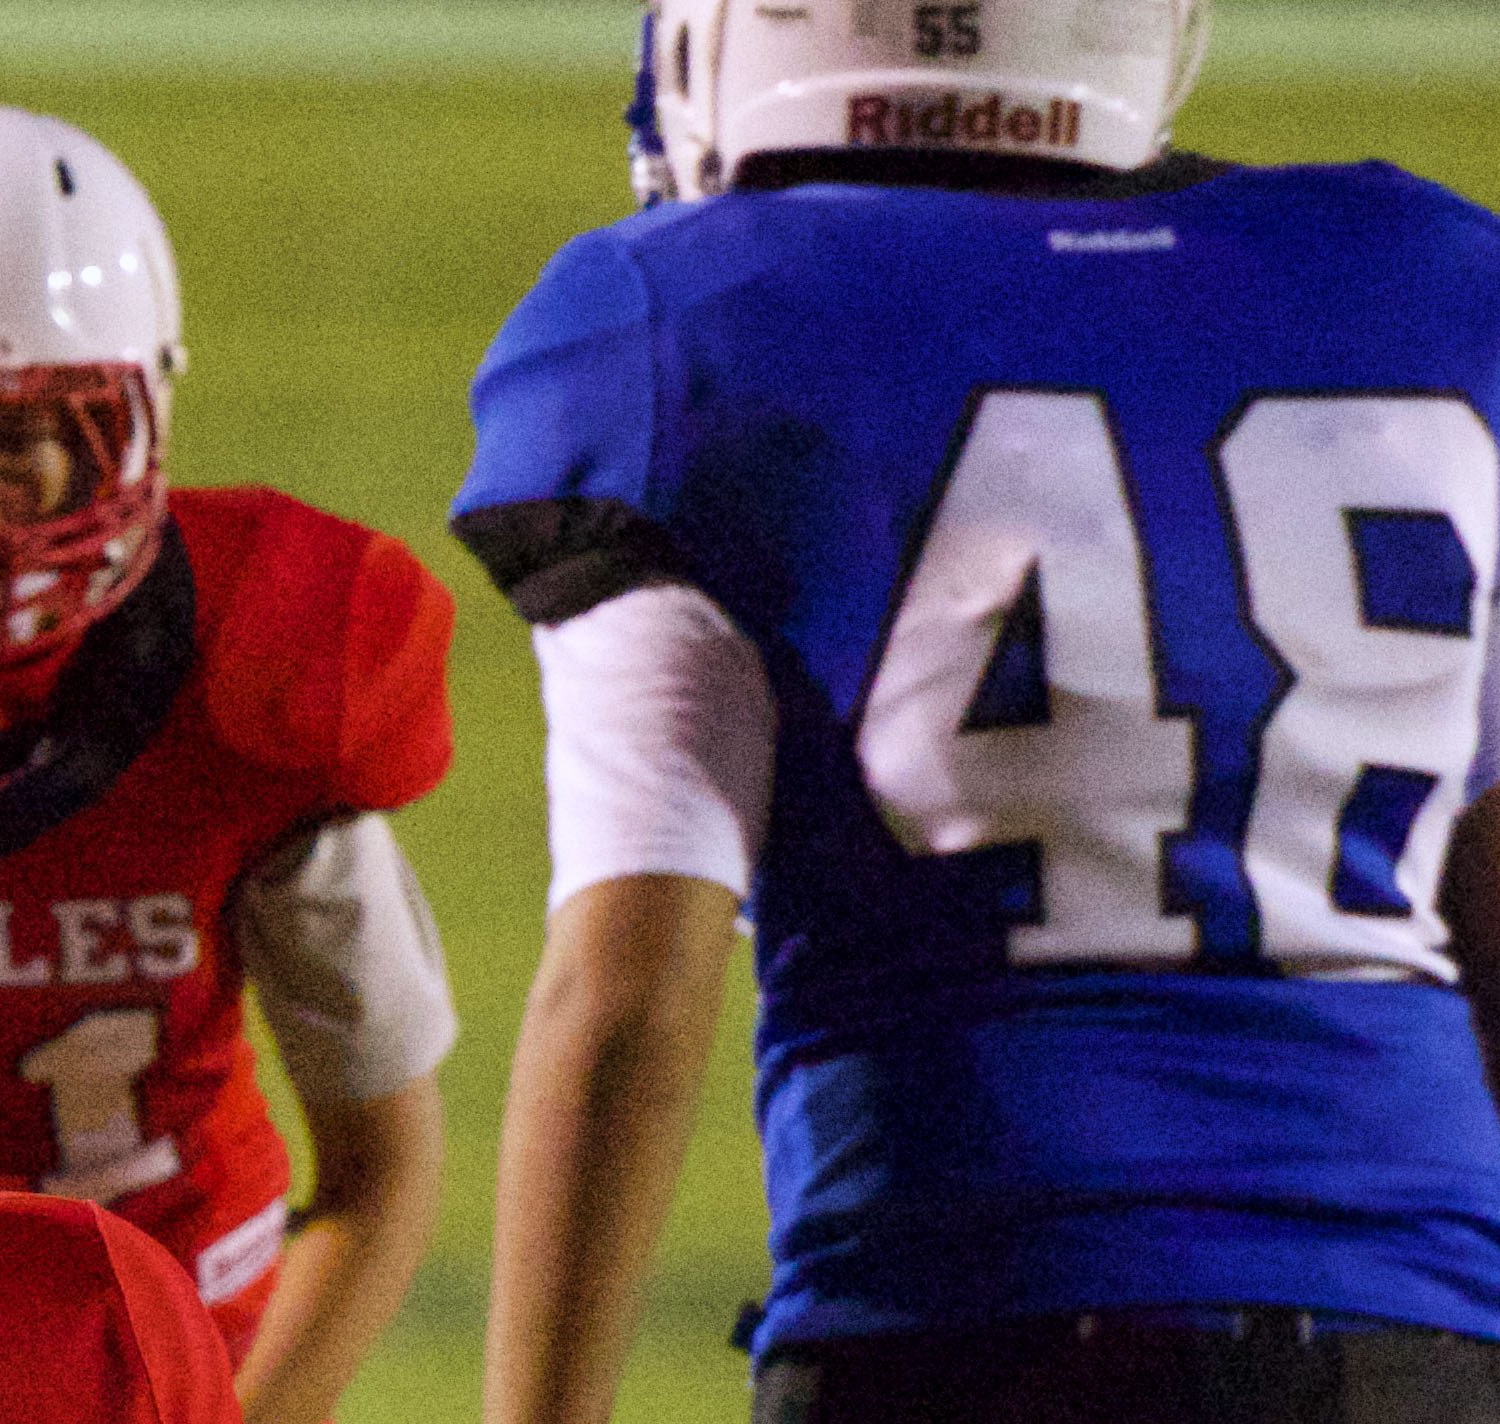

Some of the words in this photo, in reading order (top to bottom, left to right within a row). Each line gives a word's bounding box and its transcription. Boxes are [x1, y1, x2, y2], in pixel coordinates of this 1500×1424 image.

[914, 5, 982, 55] 55
[848, 92, 1081, 146] Riddell
[857, 390, 1500, 983] 48
